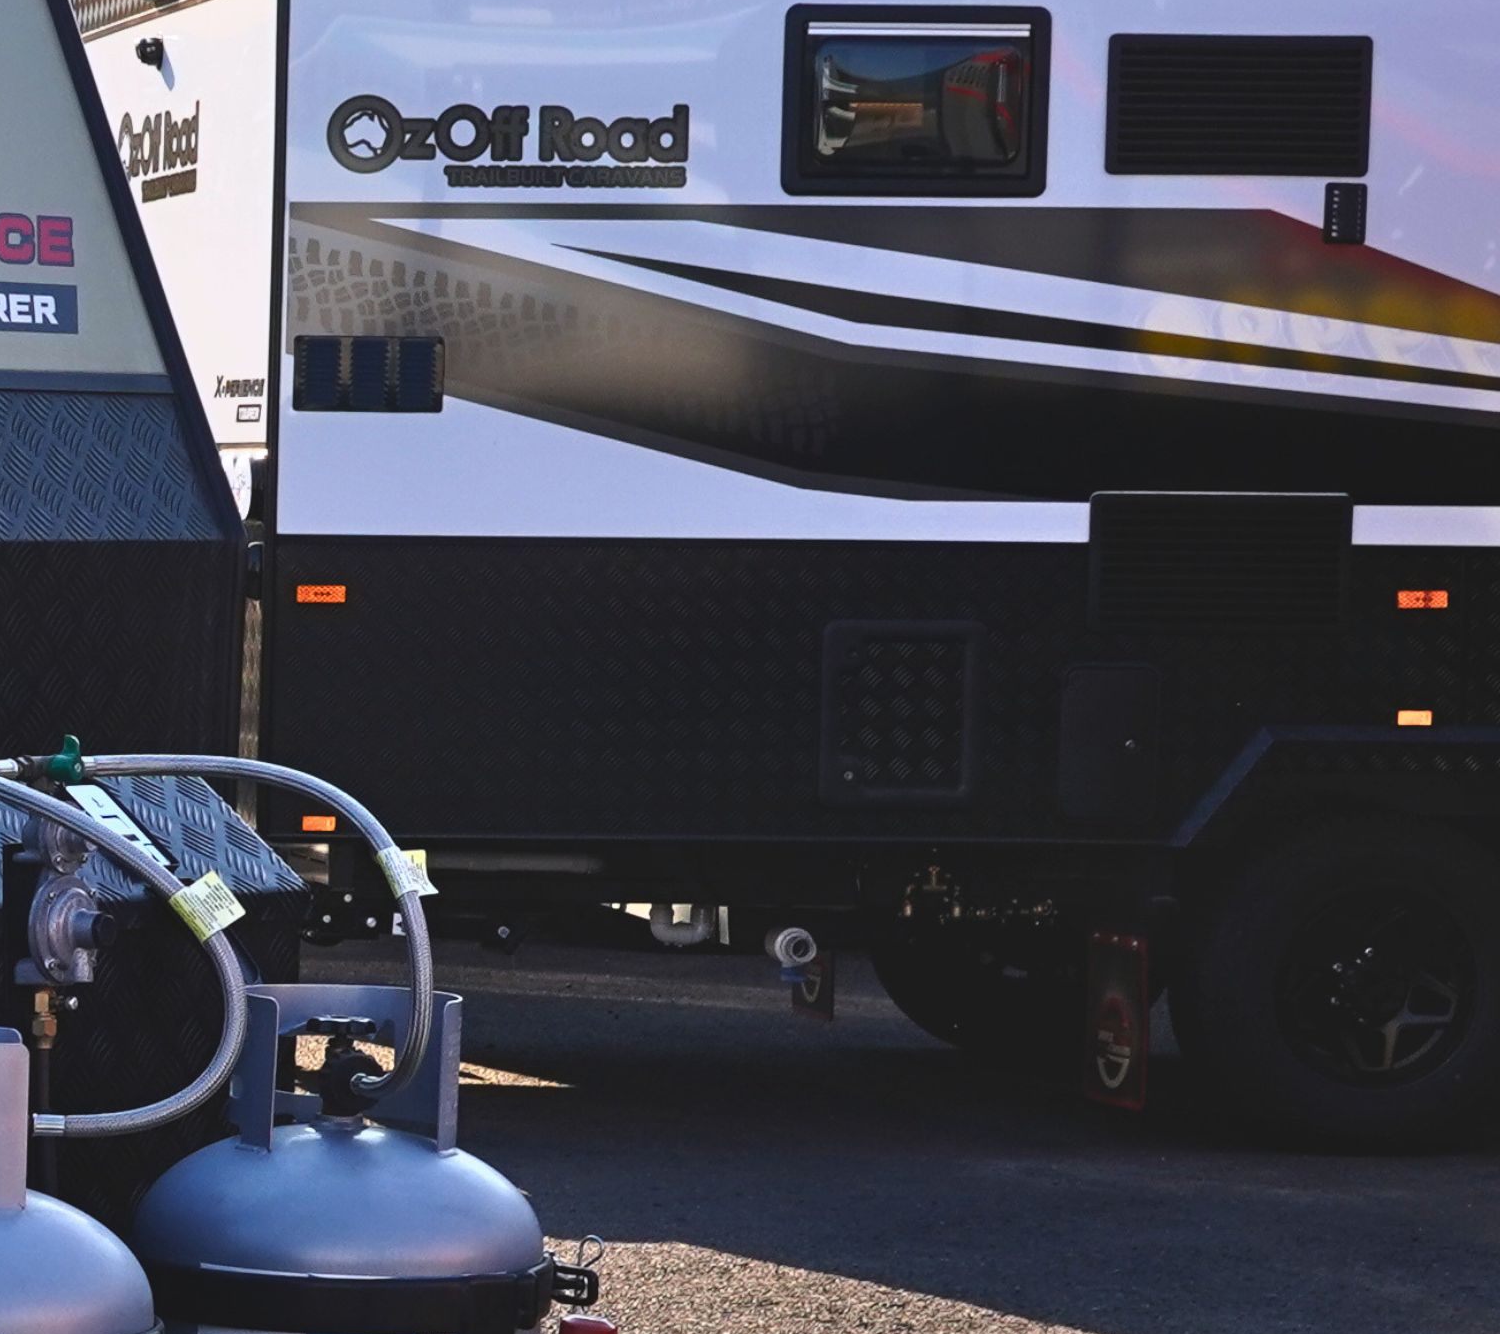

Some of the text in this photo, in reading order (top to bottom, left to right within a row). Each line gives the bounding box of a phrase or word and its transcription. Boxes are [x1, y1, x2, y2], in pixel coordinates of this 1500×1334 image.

[539, 104, 690, 163] Road
[449, 168, 683, 186] TRAILBUILT CARAVANS
